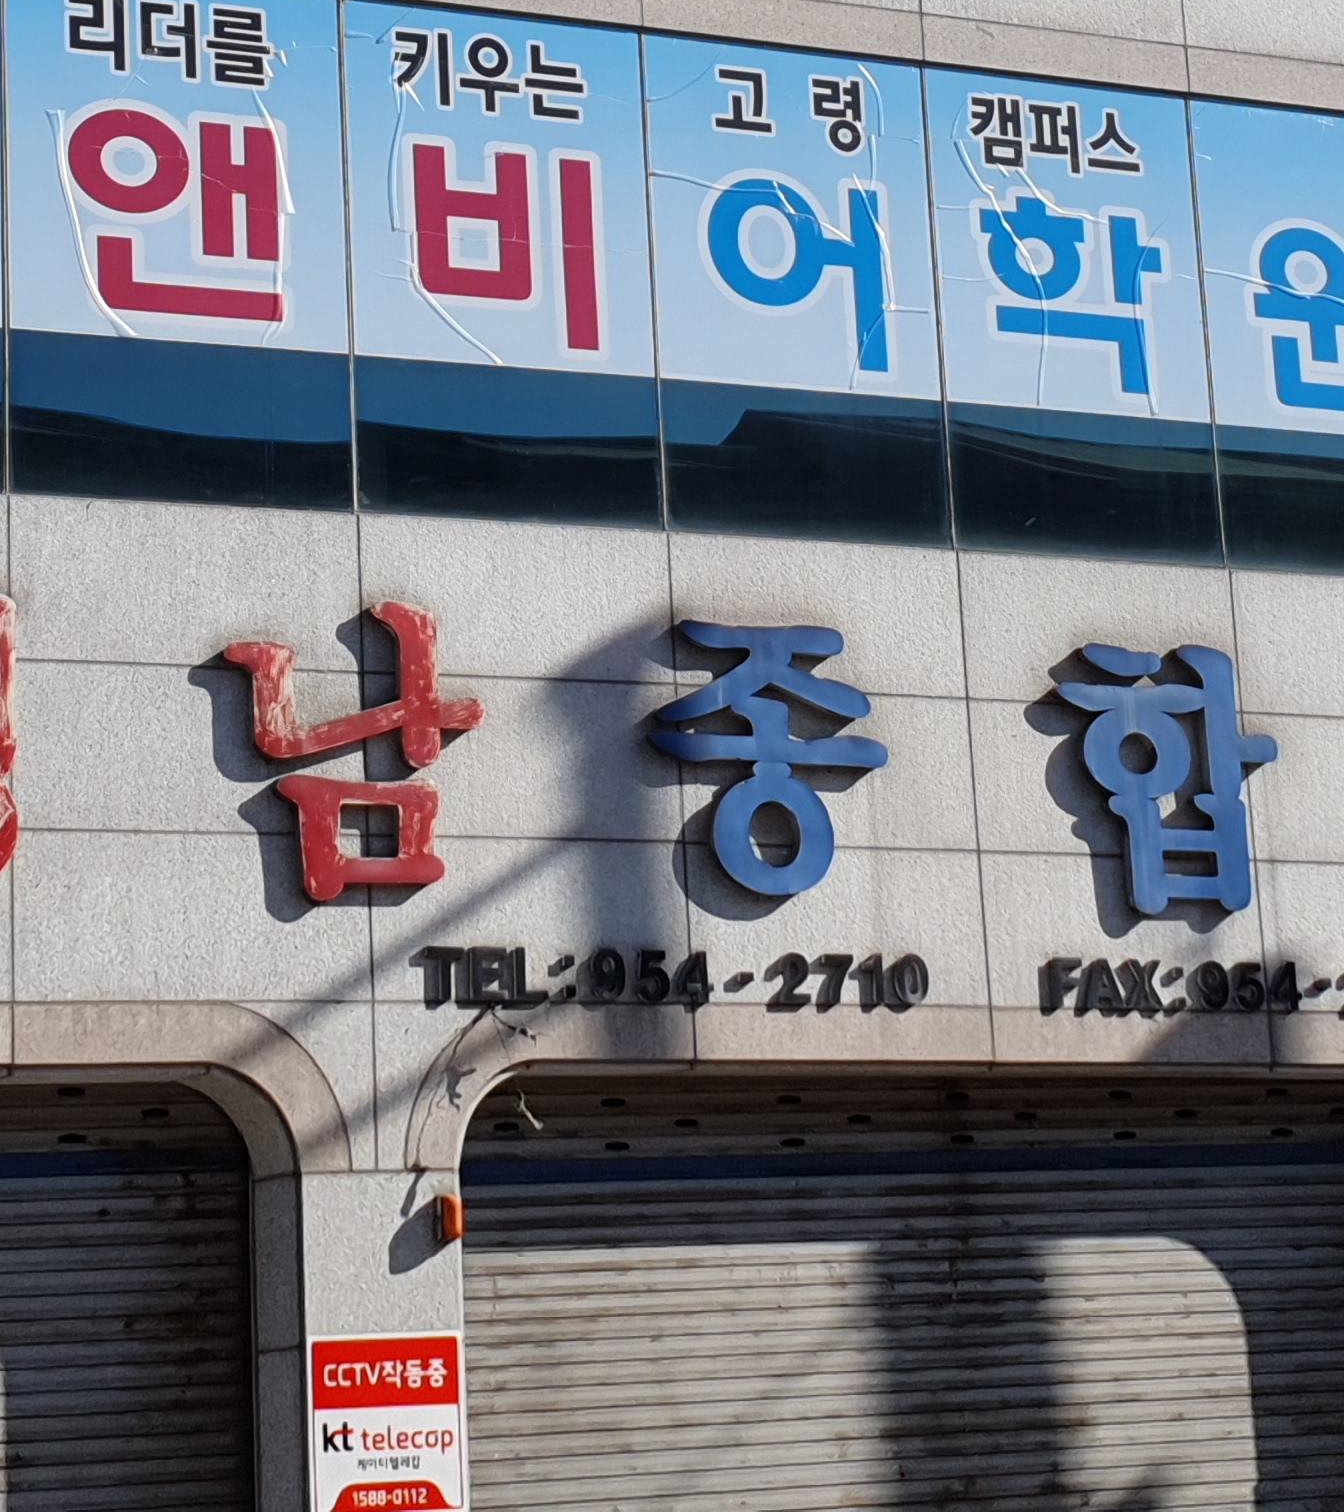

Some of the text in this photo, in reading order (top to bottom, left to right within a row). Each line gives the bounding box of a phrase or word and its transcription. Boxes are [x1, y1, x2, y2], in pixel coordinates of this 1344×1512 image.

[393, 32, 584, 122] 키우는
[714, 68, 864, 153] 고령
[969, 96, 1142, 175] 캠퍼스
[323, 1358, 447, 1389] CCTV작동중
[322, 1421, 454, 1455] kt telecop
[352, 1488, 428, 1507] 1588-0112
